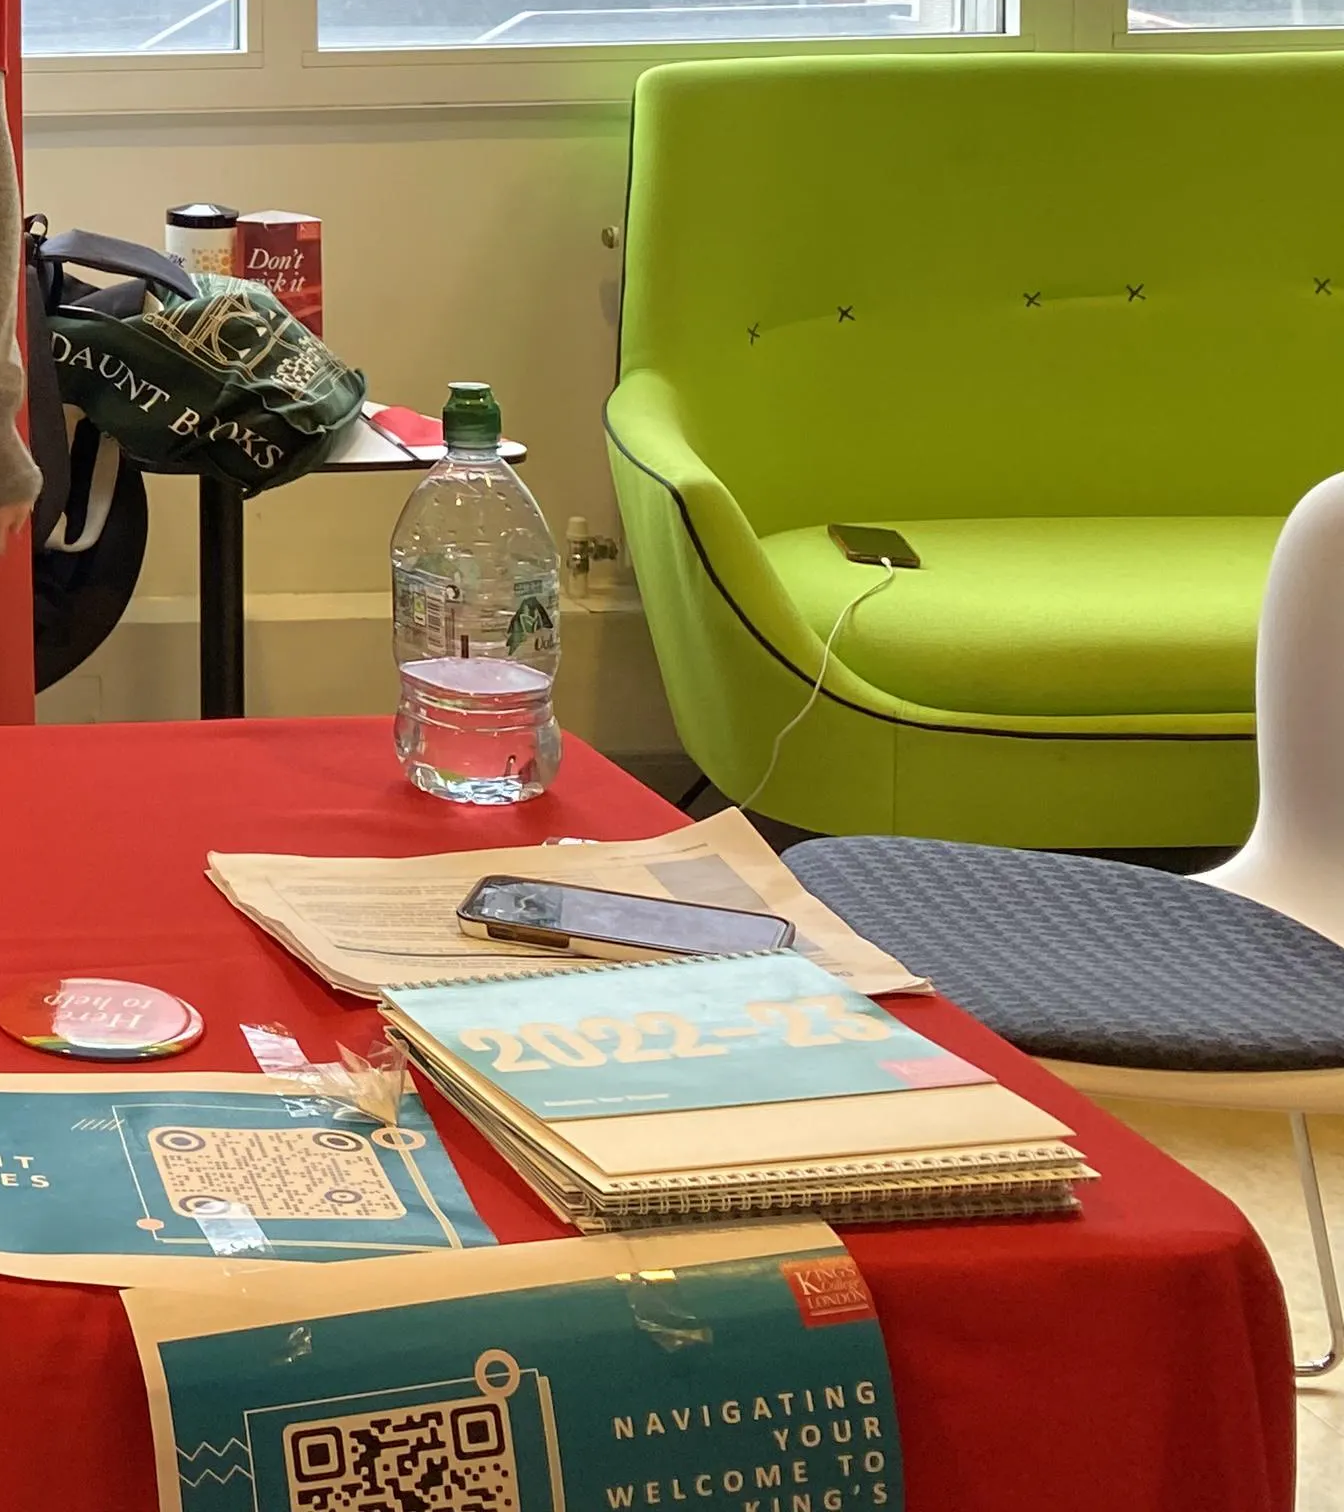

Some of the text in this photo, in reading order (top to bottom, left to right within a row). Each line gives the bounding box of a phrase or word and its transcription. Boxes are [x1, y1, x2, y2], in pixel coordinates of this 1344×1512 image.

[247, 248, 304, 269] Don't
[289, 271, 306, 292] it
[50, 331, 171, 413] DAUNT
[458, 993, 900, 1074] 2022-23
[612, 1381, 879, 1440] NAVIGATING
[772, 1415, 884, 1453] YOUR
[605, 1449, 887, 1511] WELCOME TO
